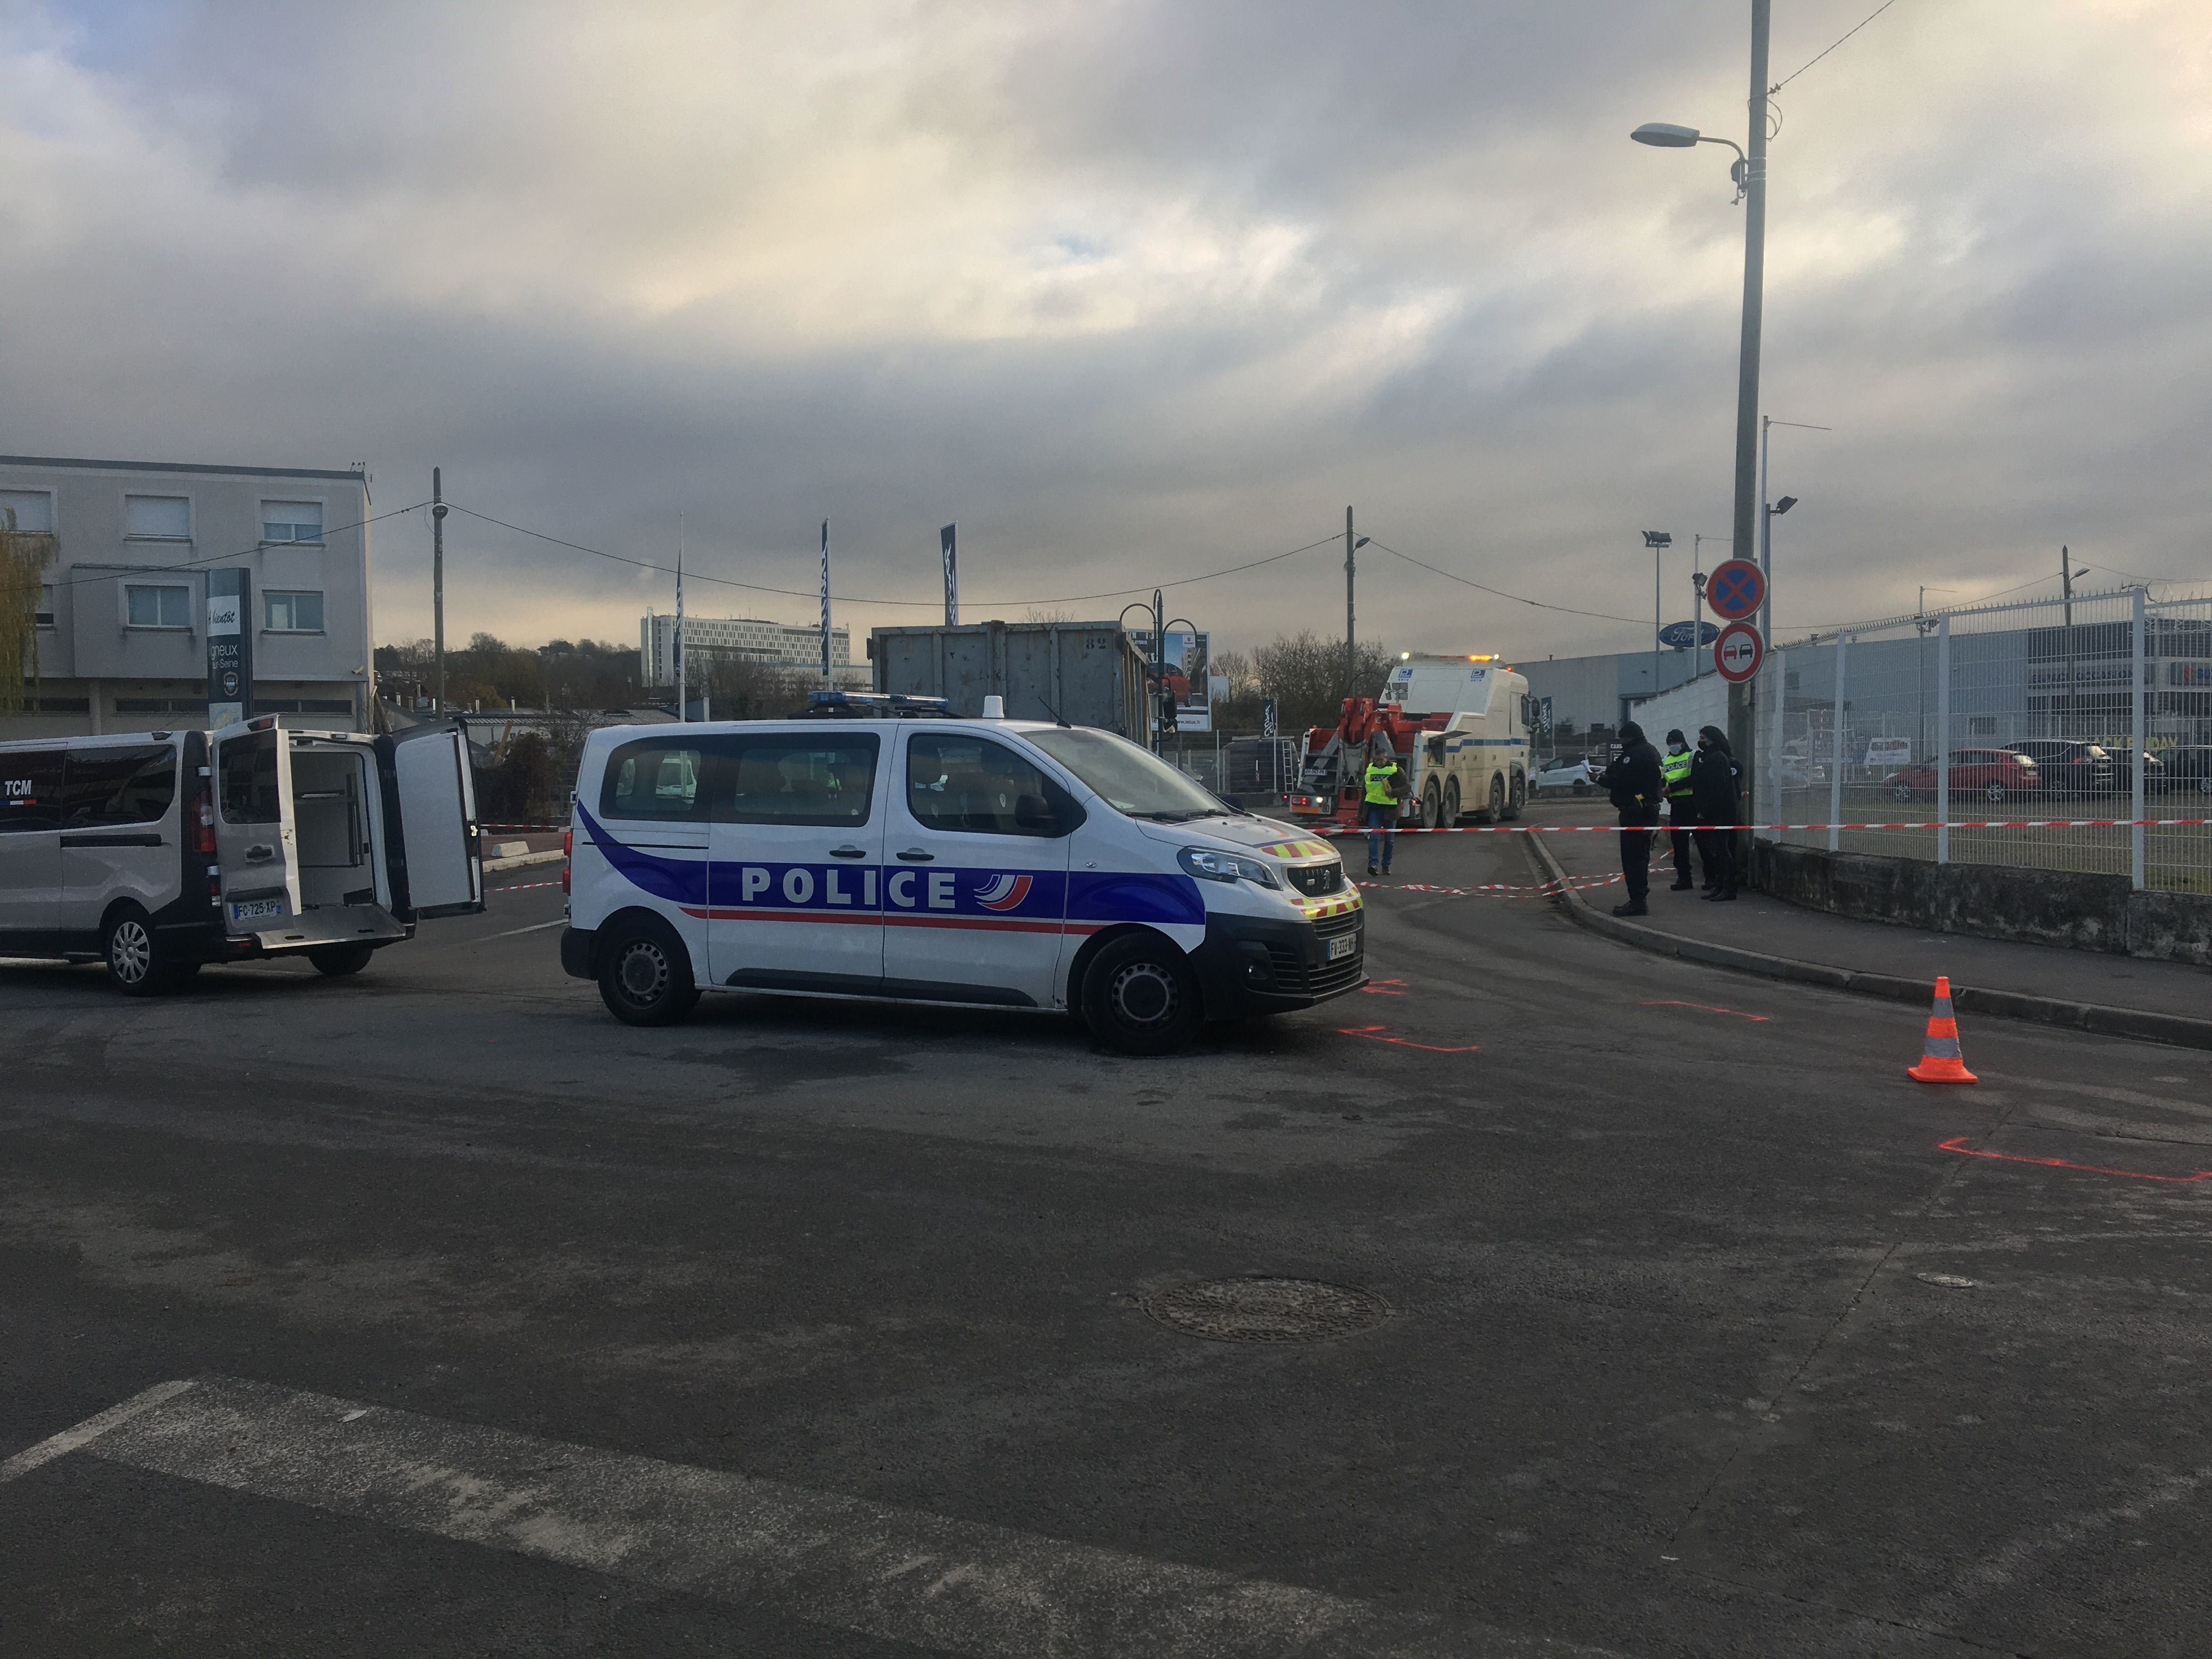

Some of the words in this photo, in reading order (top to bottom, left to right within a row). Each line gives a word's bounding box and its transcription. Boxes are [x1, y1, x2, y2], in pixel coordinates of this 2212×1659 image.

[212, 609, 235, 624] bientôt
[1671, 627, 1705, 642] For
[1086, 637, 1106, 650] 82
[209, 644, 238, 660] igneux
[1664, 760, 1687, 772] POLICE
[5, 780, 32, 795] TCM
[742, 867, 955, 909] POLICE
[238, 901, 275, 916] FC-725-XP
